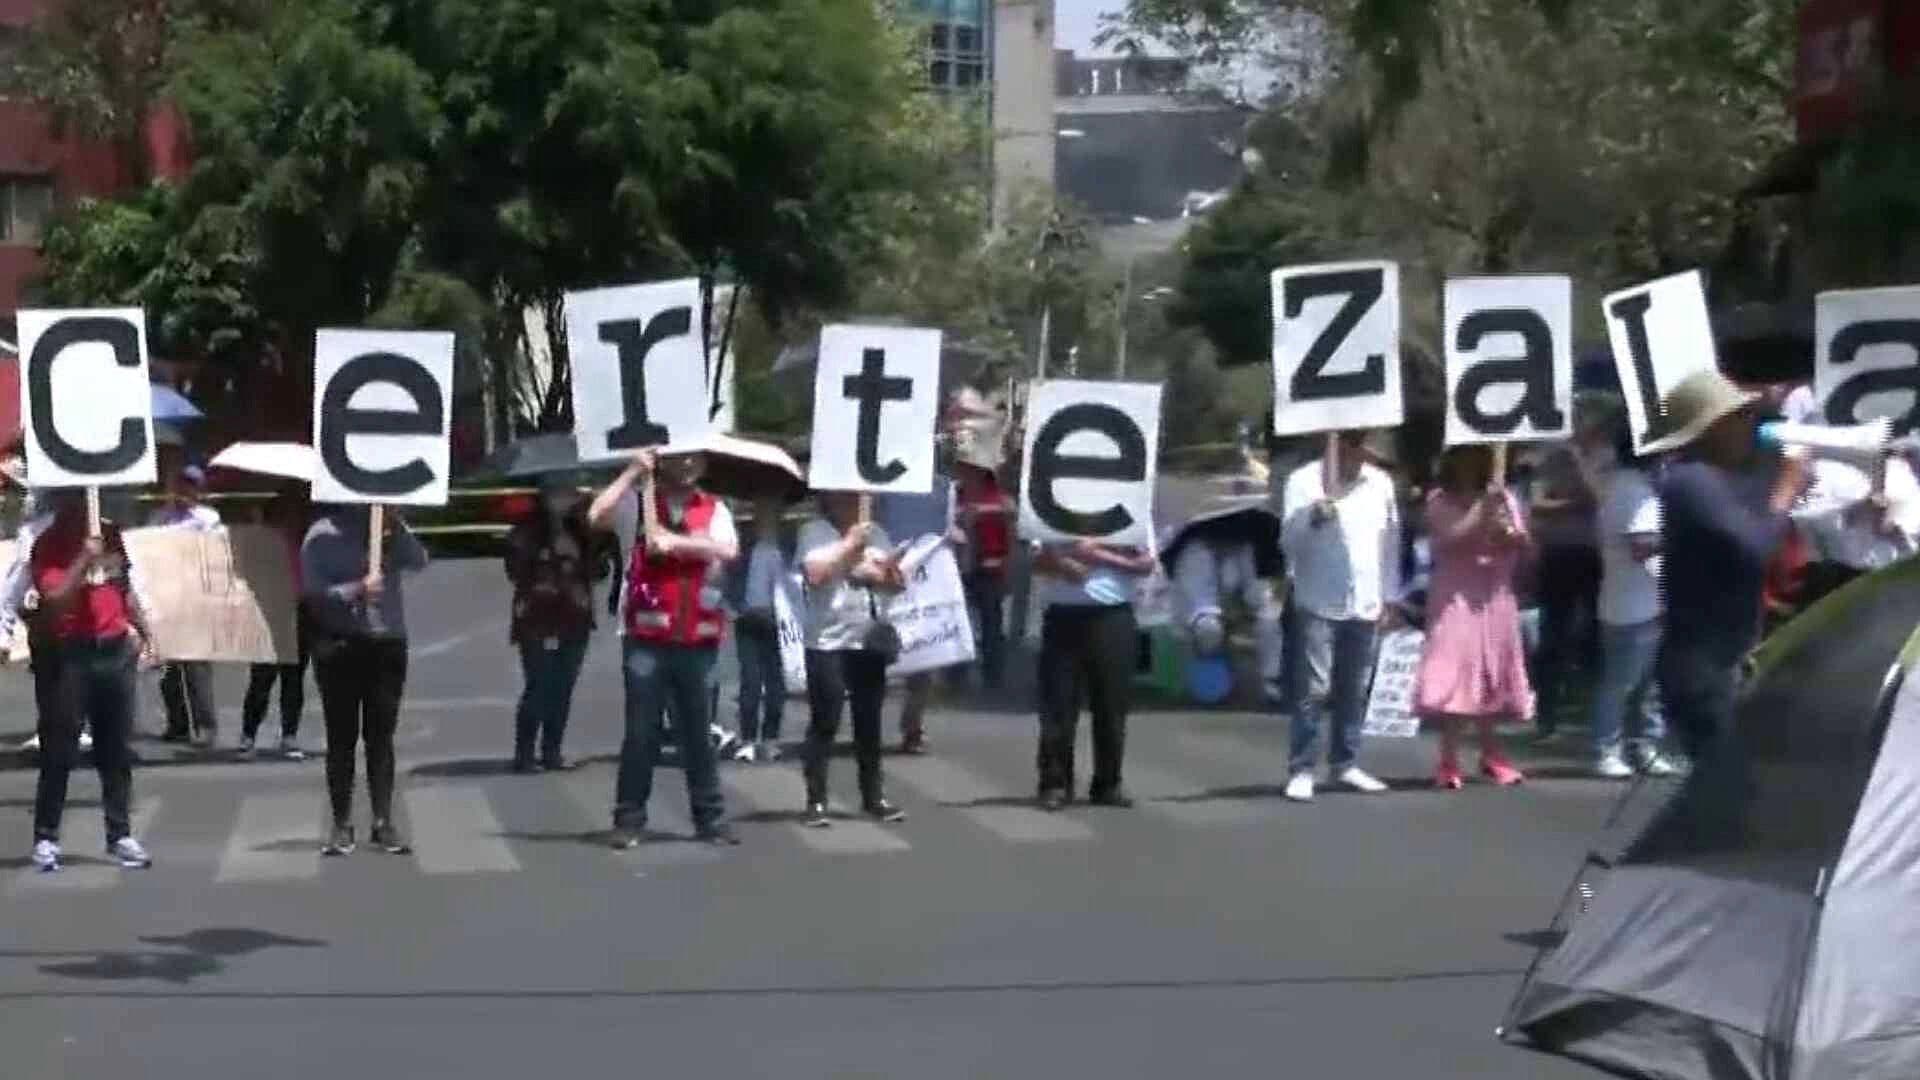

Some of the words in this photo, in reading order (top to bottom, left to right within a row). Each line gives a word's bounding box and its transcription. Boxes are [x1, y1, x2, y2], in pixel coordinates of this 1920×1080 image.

[319, 352, 443, 495] e
[598, 306, 692, 450] r
[843, 348, 913, 484] t
[1455, 308, 1563, 435] a
[1027, 403, 1147, 536] e
